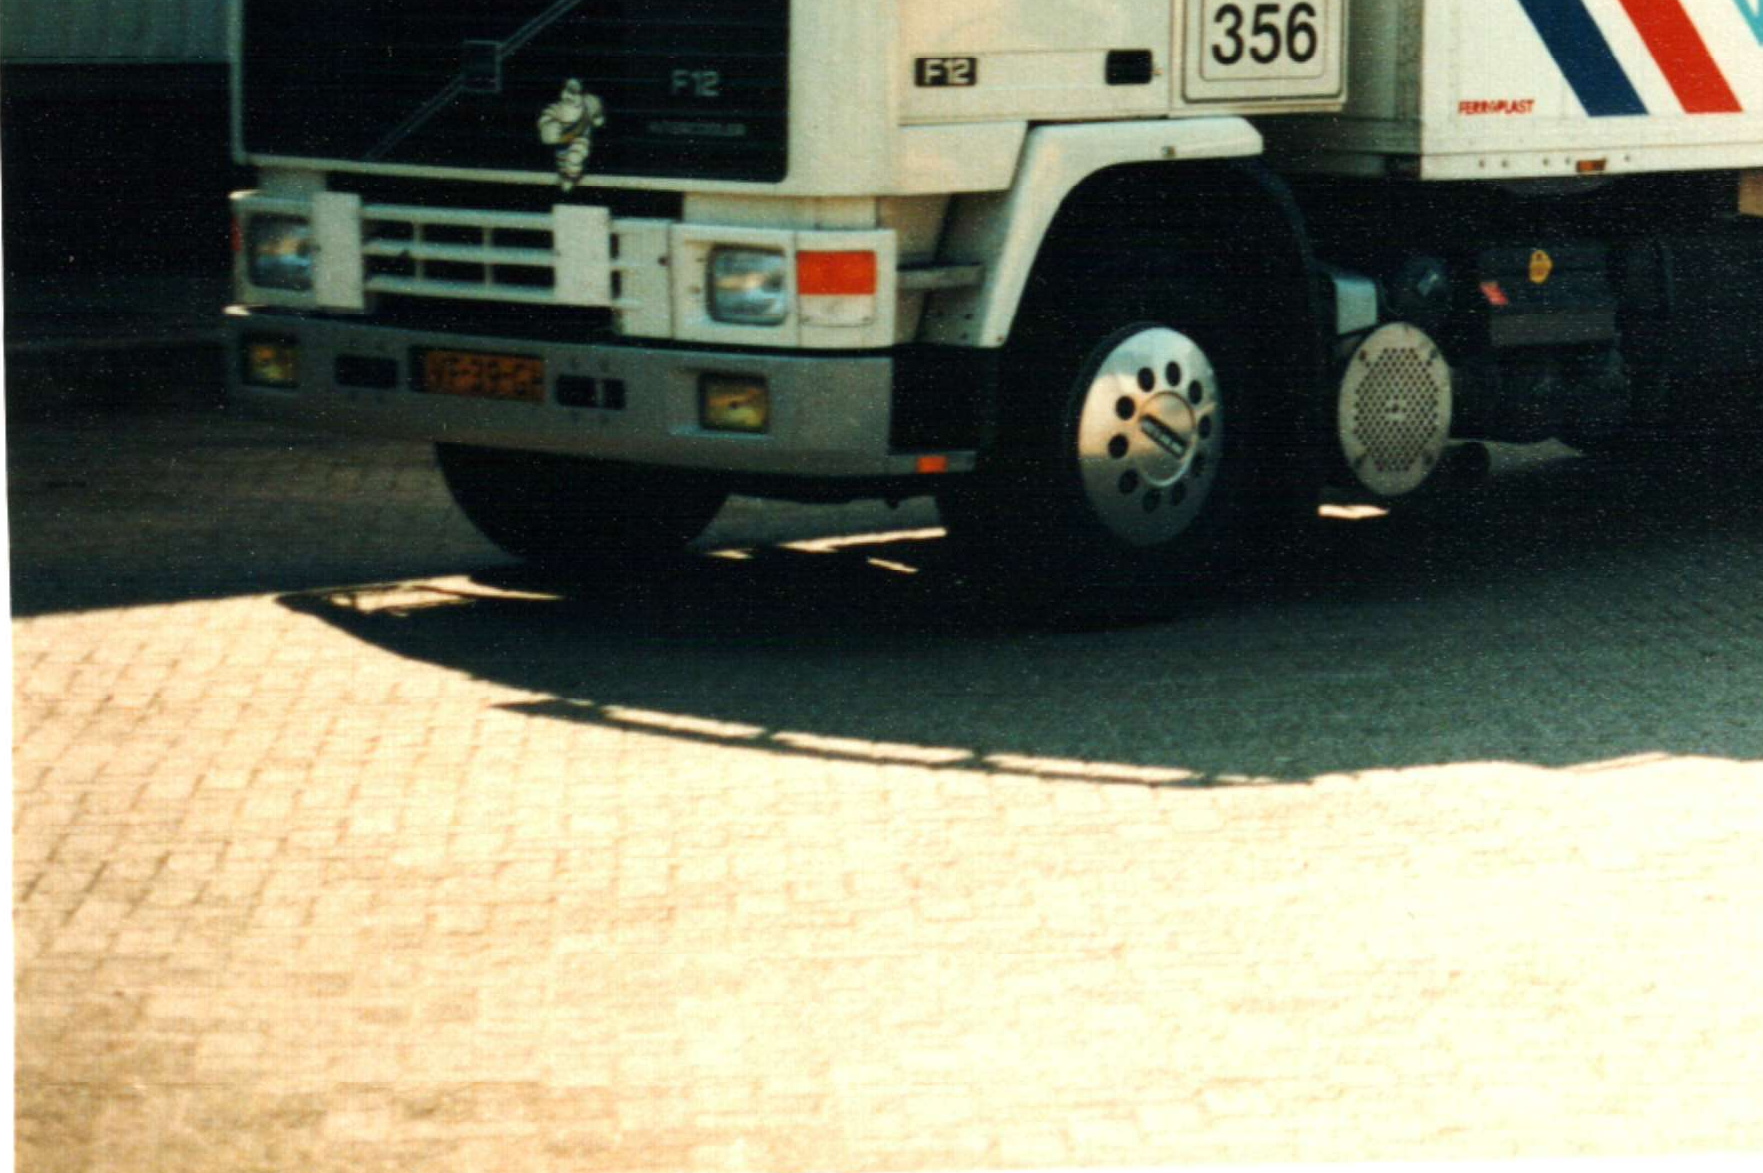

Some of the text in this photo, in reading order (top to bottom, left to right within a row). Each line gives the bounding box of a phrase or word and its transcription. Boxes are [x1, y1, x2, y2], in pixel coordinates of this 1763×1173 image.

[1211, 1, 1319, 66] 356
[672, 68, 719, 97] F12
[922, 58, 971, 84] F12
